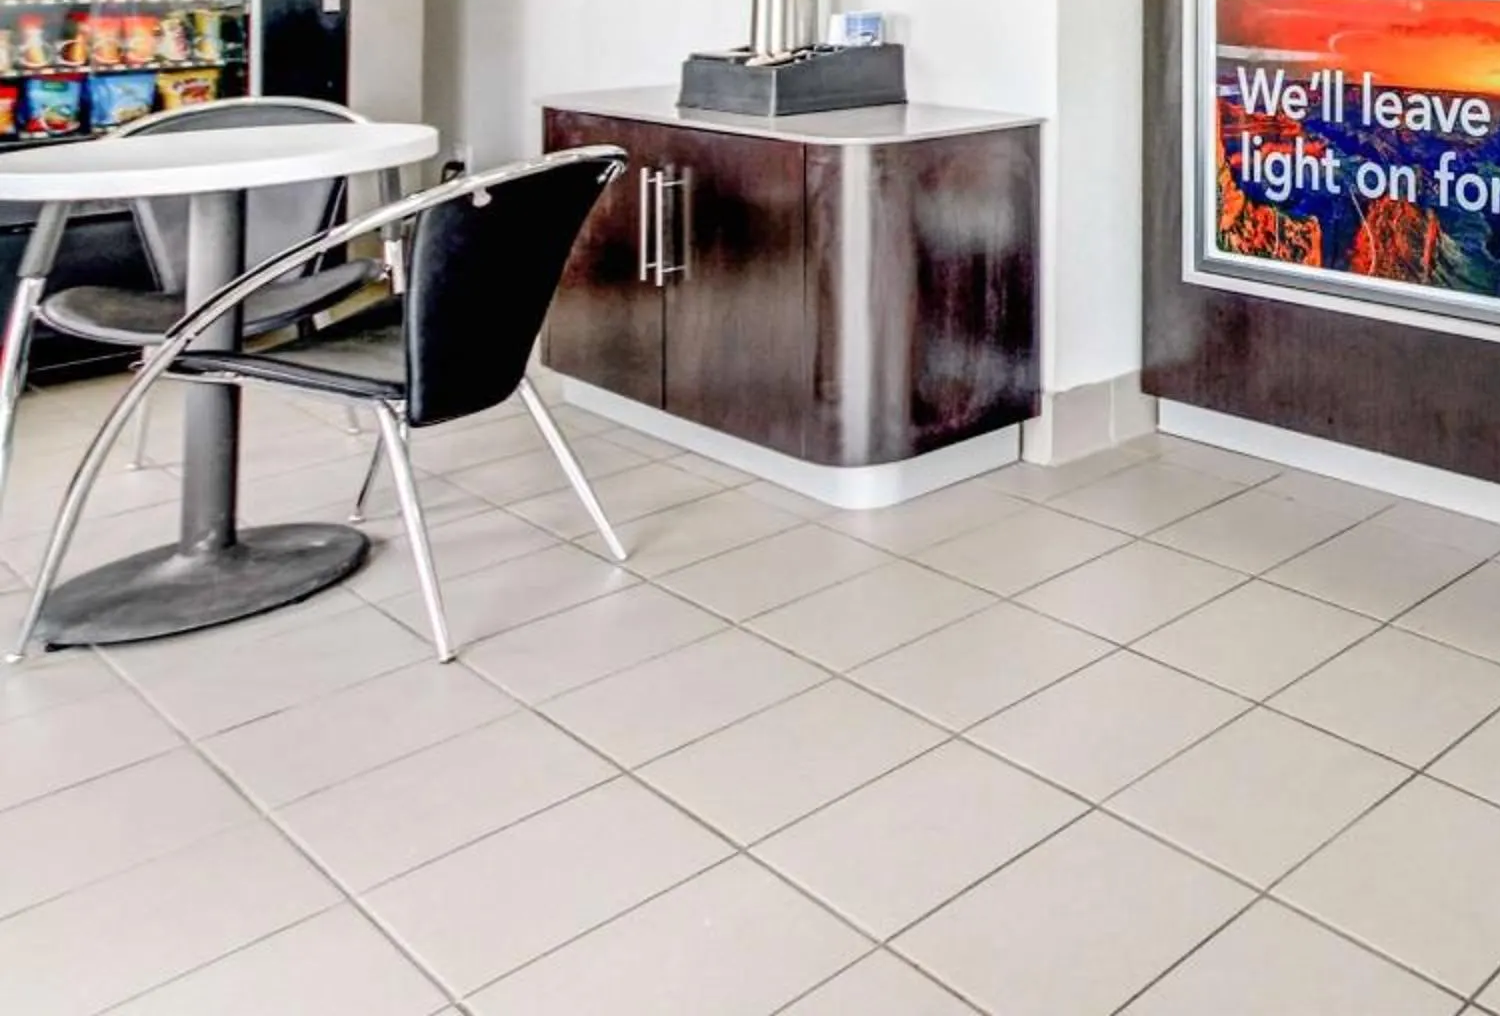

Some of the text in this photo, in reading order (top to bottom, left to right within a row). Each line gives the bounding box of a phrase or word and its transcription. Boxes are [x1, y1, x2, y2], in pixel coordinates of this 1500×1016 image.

[1361, 70, 1490, 136] leave
[1241, 132, 1341, 203] light
[1356, 161, 1415, 203] on
